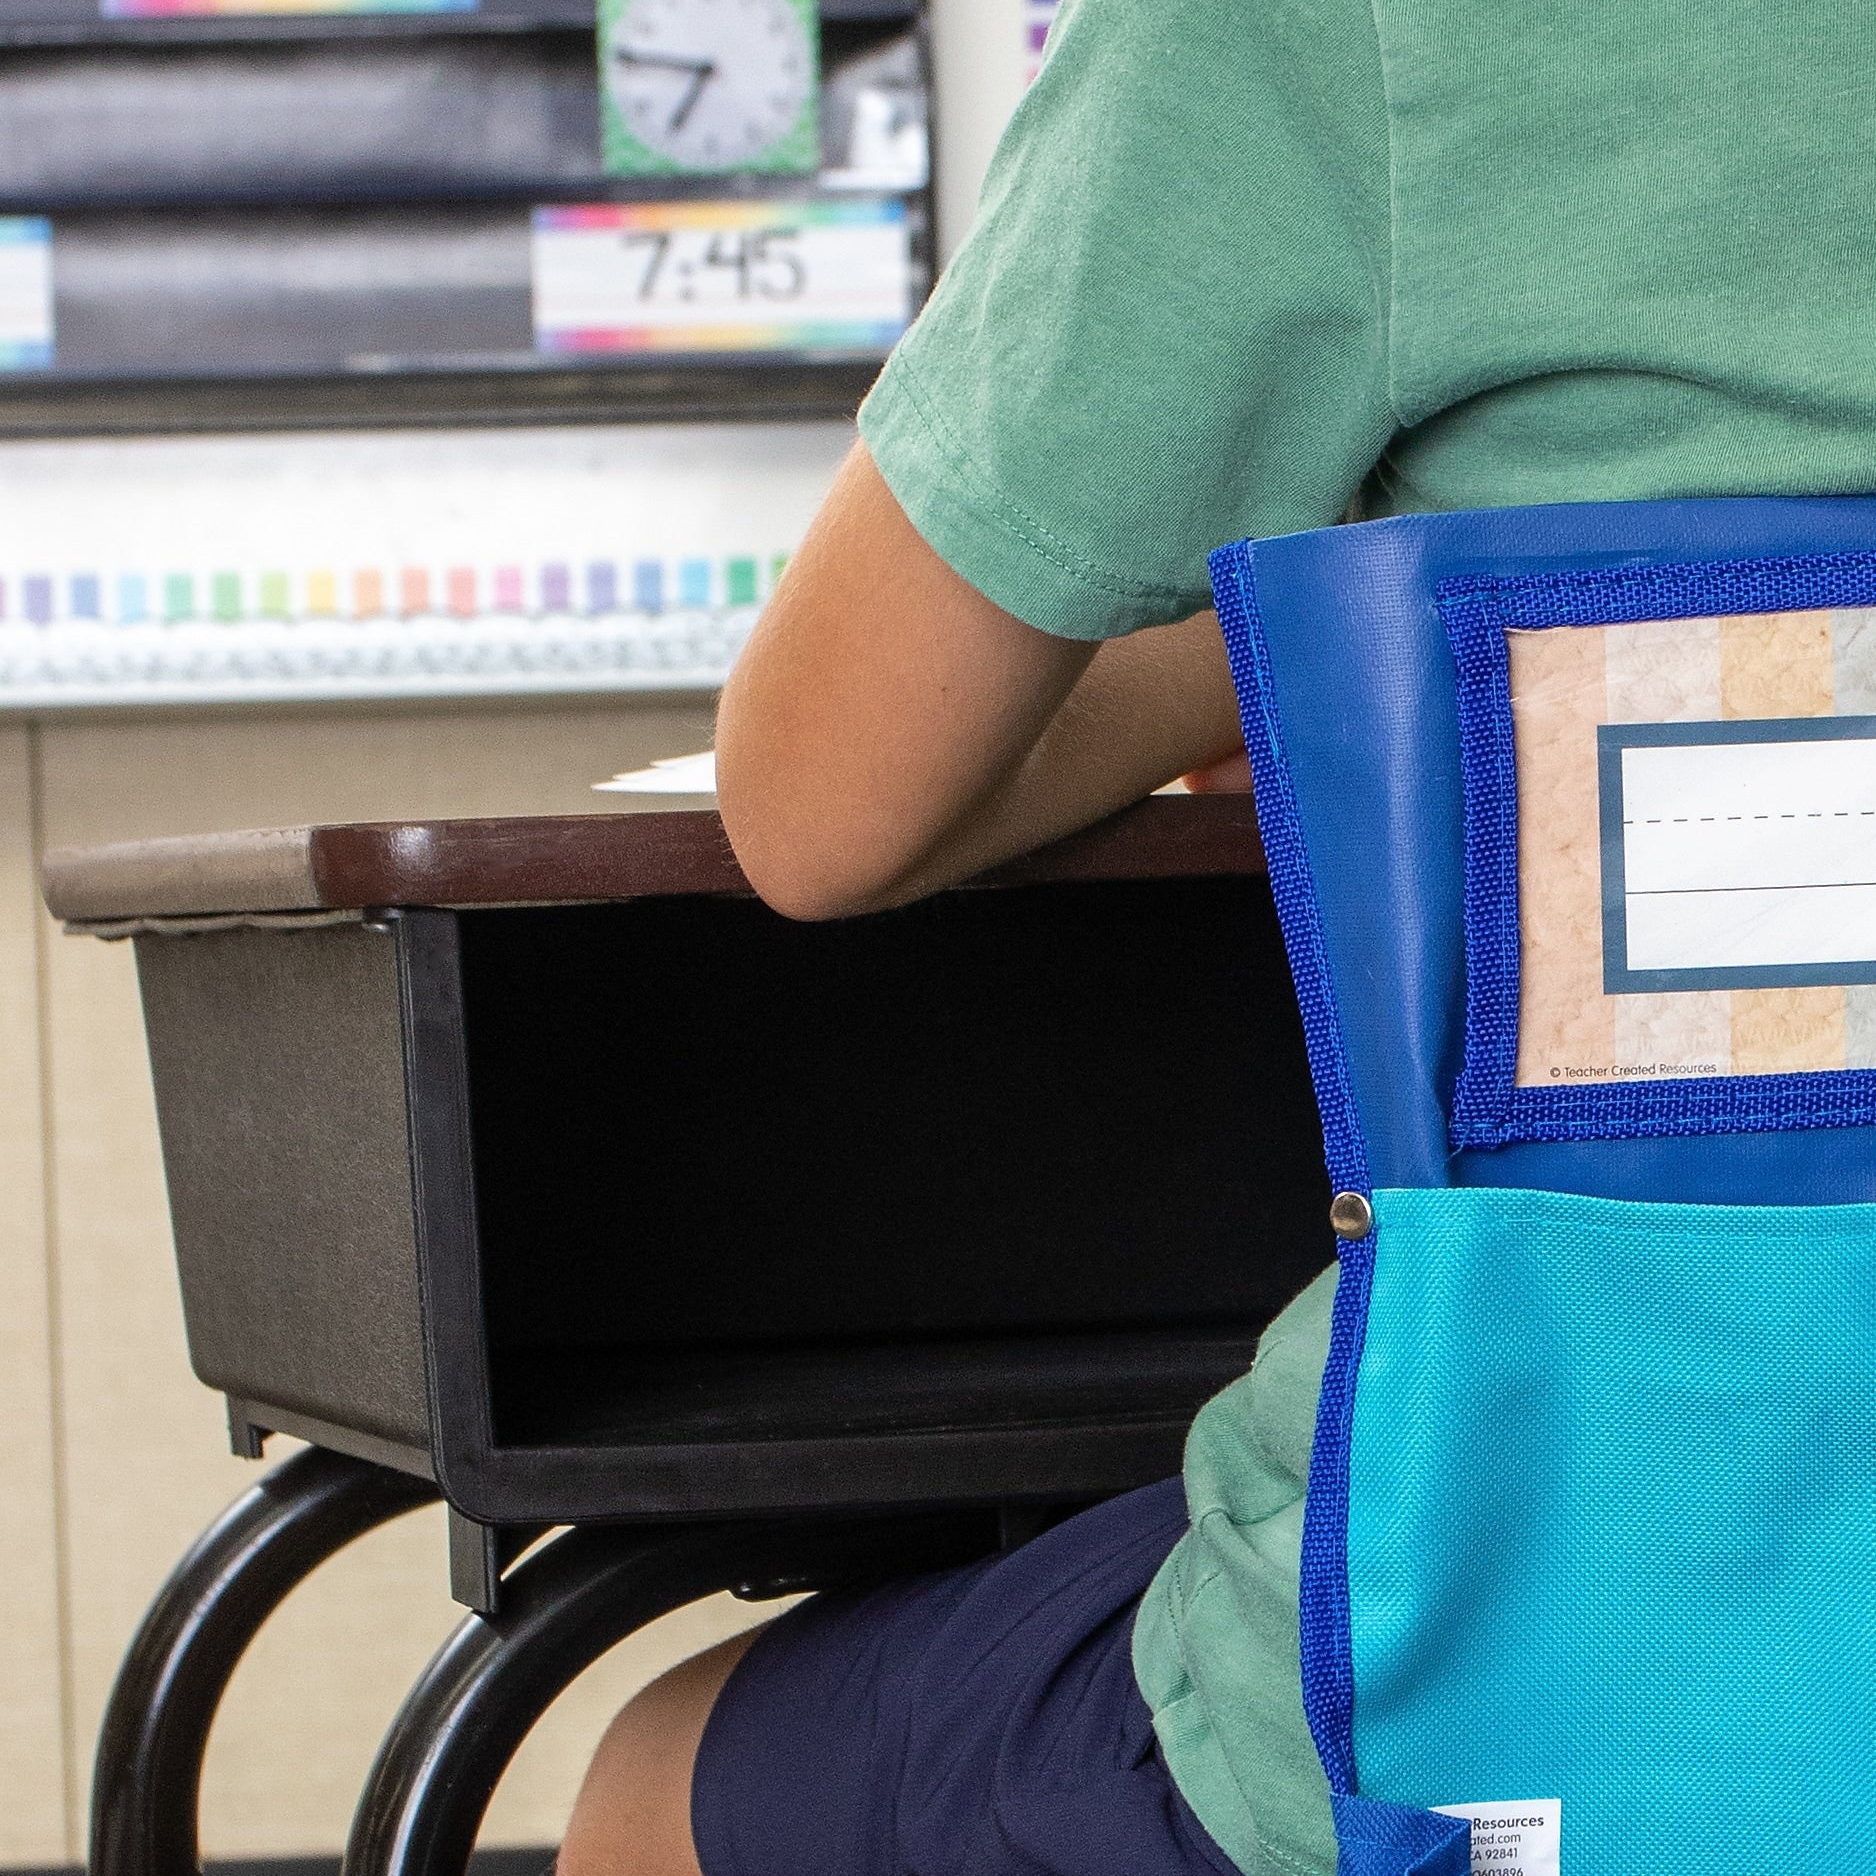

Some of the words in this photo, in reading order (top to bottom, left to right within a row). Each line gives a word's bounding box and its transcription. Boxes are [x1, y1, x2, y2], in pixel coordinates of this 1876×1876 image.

[621, 224, 806, 301] 7:45
[1565, 1066, 1608, 1078] Teacher
[1611, 1063, 1656, 1076] Created
[1659, 1063, 1717, 1074] Resources
[1473, 1817, 1545, 1830] Resources
[1485, 1848, 1518, 1860] 92841
